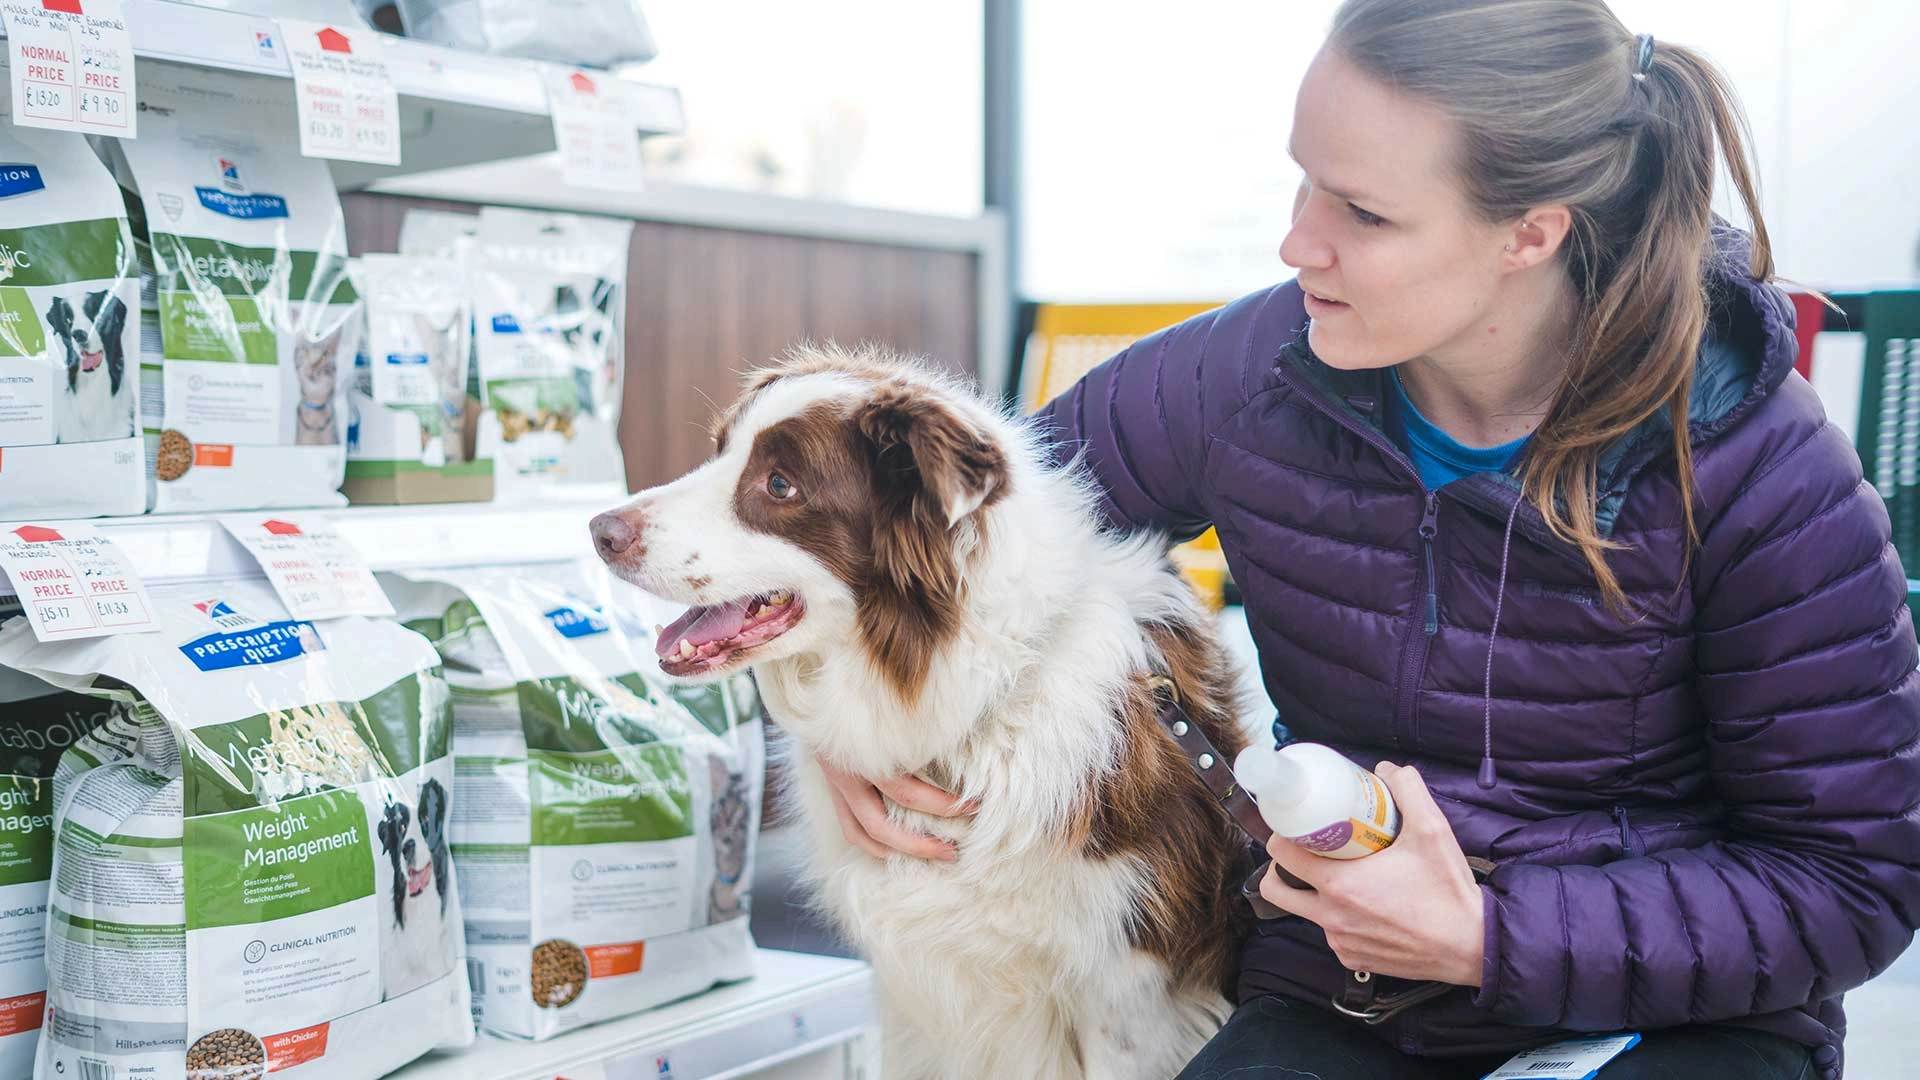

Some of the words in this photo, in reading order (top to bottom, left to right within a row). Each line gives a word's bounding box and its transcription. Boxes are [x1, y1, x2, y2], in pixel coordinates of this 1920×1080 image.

[21, 45, 70, 64] NORMAL
[28, 64, 65, 82] PRICE
[85, 72, 120, 90] PRICE
[20, 568, 72, 582] NORMAL
[34, 584, 73, 598] PRICE
[91, 580, 128, 593] PRICE
[242, 812, 310, 843] Weight
[244, 826, 360, 868] Management
[243, 878, 270, 887] Gestion
[243, 887, 273, 896] Gestione
[270, 940, 314, 953] CLINICAL
[315, 925, 357, 944] NUTRITION
[115, 1039, 186, 1049] HillsPet.com
[273, 1036, 292, 1048] with
[291, 1031, 319, 1044] Chicken
